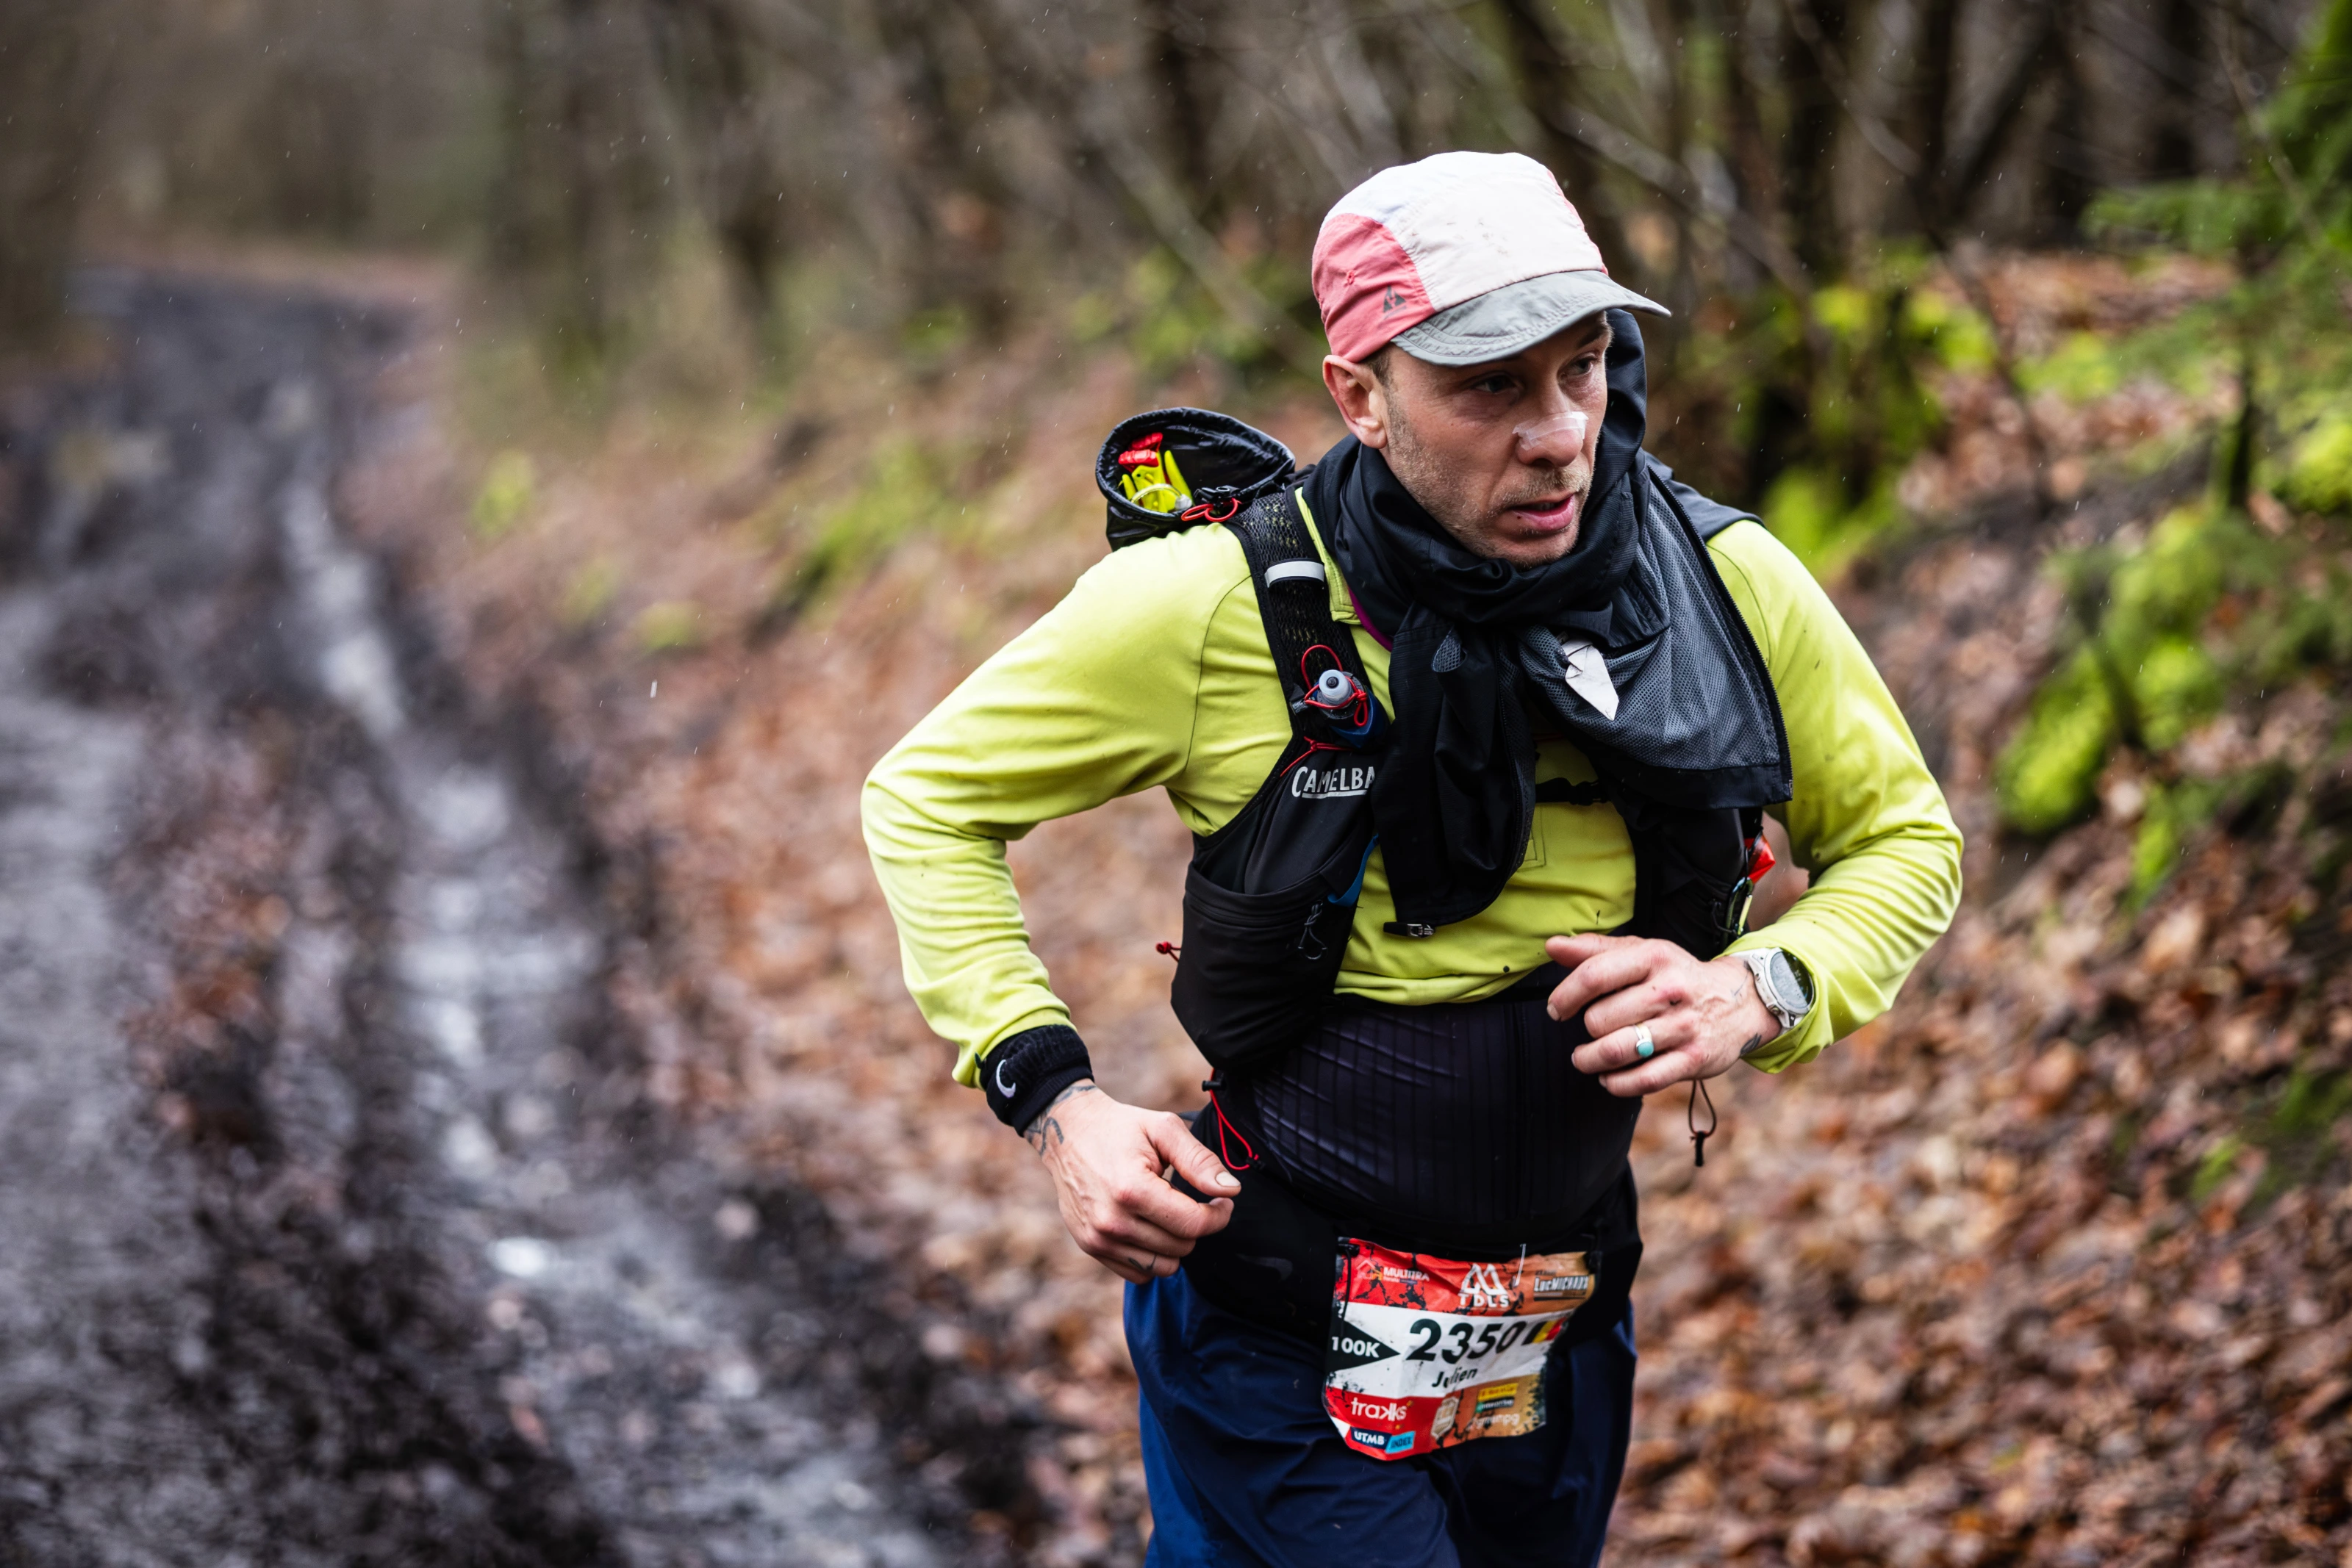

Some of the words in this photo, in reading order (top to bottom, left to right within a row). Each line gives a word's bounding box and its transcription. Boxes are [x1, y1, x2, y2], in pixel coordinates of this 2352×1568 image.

[1458, 1293, 1510, 1309] TDLS
[1331, 1336, 1383, 1359] 100K
[1406, 1318, 1527, 1364] 2350
[1354, 1431, 1385, 1445] UTMB
